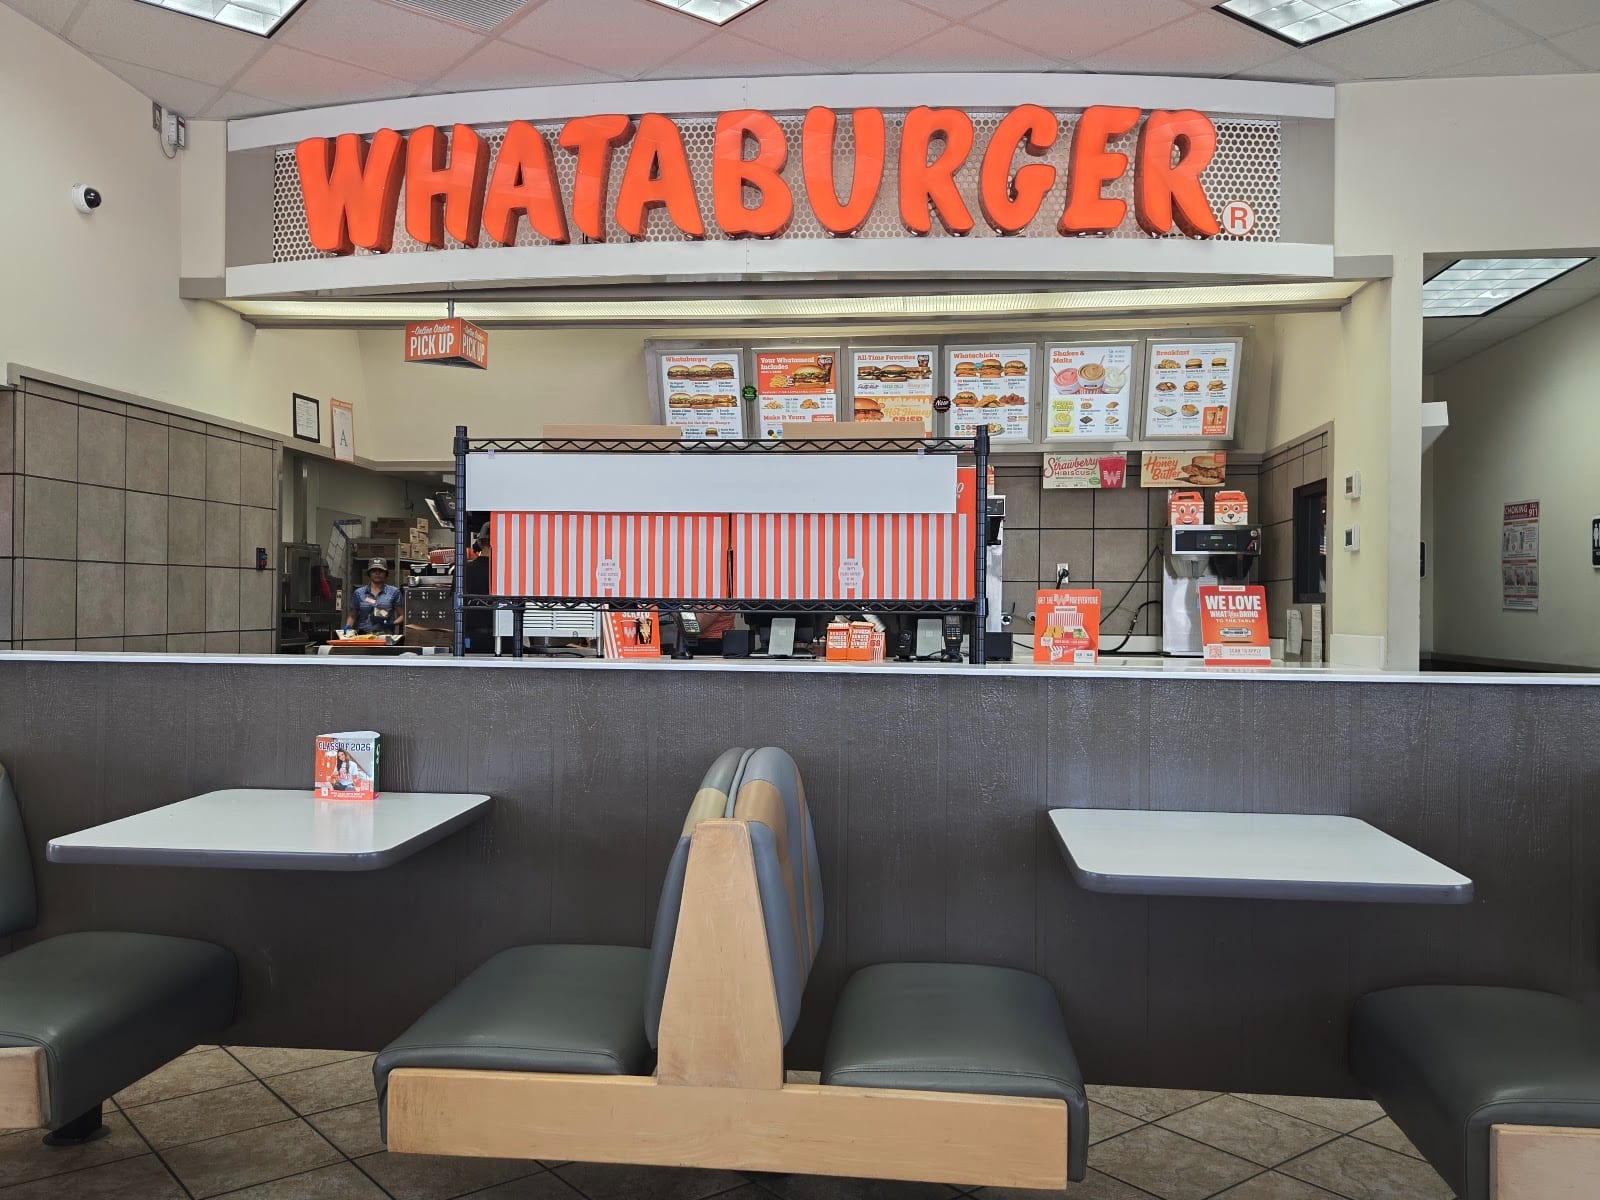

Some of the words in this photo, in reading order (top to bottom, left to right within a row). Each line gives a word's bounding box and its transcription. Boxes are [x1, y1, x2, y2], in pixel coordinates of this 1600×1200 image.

[296, 104, 1220, 256] WHATABURGER
[410, 335, 436, 357] PICK
[439, 333, 454, 354] UP
[463, 334, 476, 359] PICK
[477, 341, 485, 363] UP
[340, 429, 348, 447] A
[1043, 457, 1103, 478] Strawberry
[1144, 456, 1179, 473] Honey
[1152, 468, 1182, 481] Butter
[1529, 508, 1538, 517] 911
[1205, 595, 1226, 610] WE
[1228, 595, 1261, 610] LOVE
[318, 741, 338, 750] CLASS
[350, 743, 371, 751] 2026
